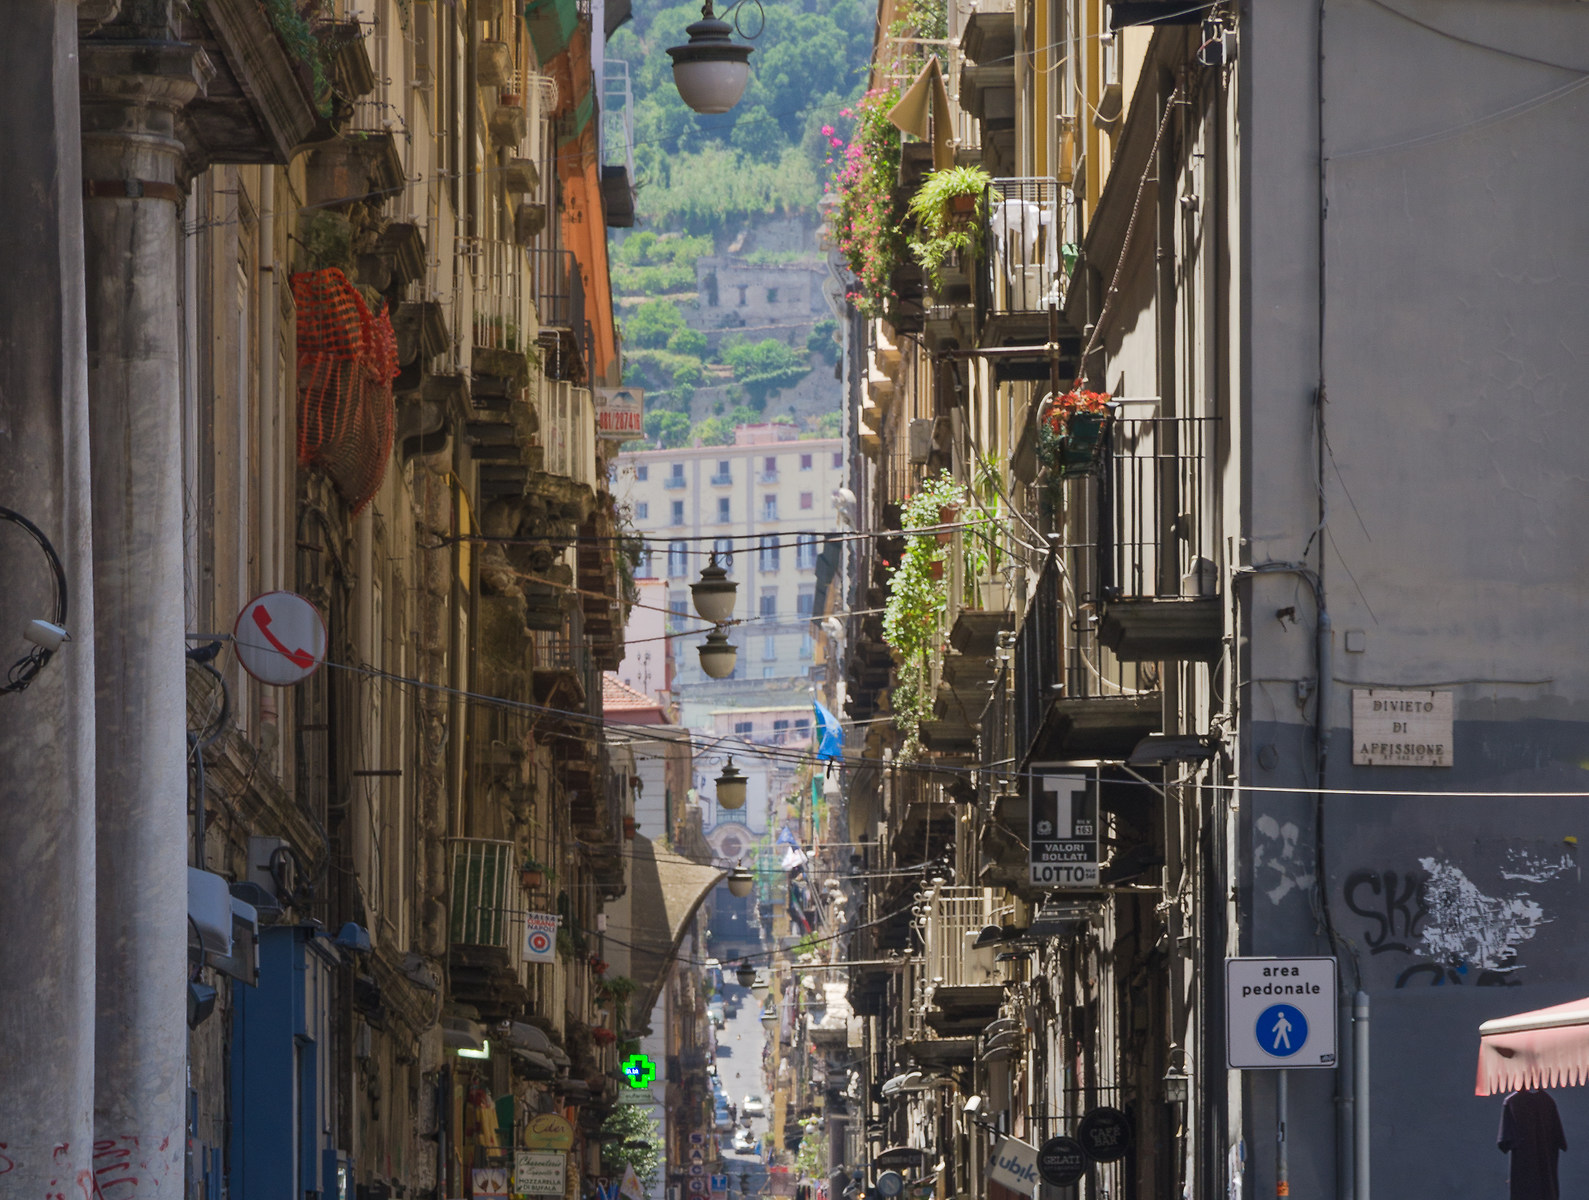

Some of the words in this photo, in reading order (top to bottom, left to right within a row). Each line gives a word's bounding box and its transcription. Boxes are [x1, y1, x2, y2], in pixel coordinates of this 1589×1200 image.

[1373, 700, 1434, 712] DIVIETO
[1393, 722, 1407, 733] DI
[1360, 743, 1444, 755] AFFISSIONE
[1043, 774, 1086, 839] T
[1045, 843, 1084, 852] VALORI
[1042, 853, 1087, 861] BOLLATI
[1033, 866, 1084, 882] LOTTO
[529, 913, 555, 921] SALSA
[528, 919, 555, 927] CUBANA
[1263, 967, 1299, 977] area
[1242, 982, 1320, 998] pedonale
[1043, 1155, 1080, 1165] GELATI
[999, 1156, 1038, 1183] ubik
[519, 1178, 561, 1186] MOZZARELLA
